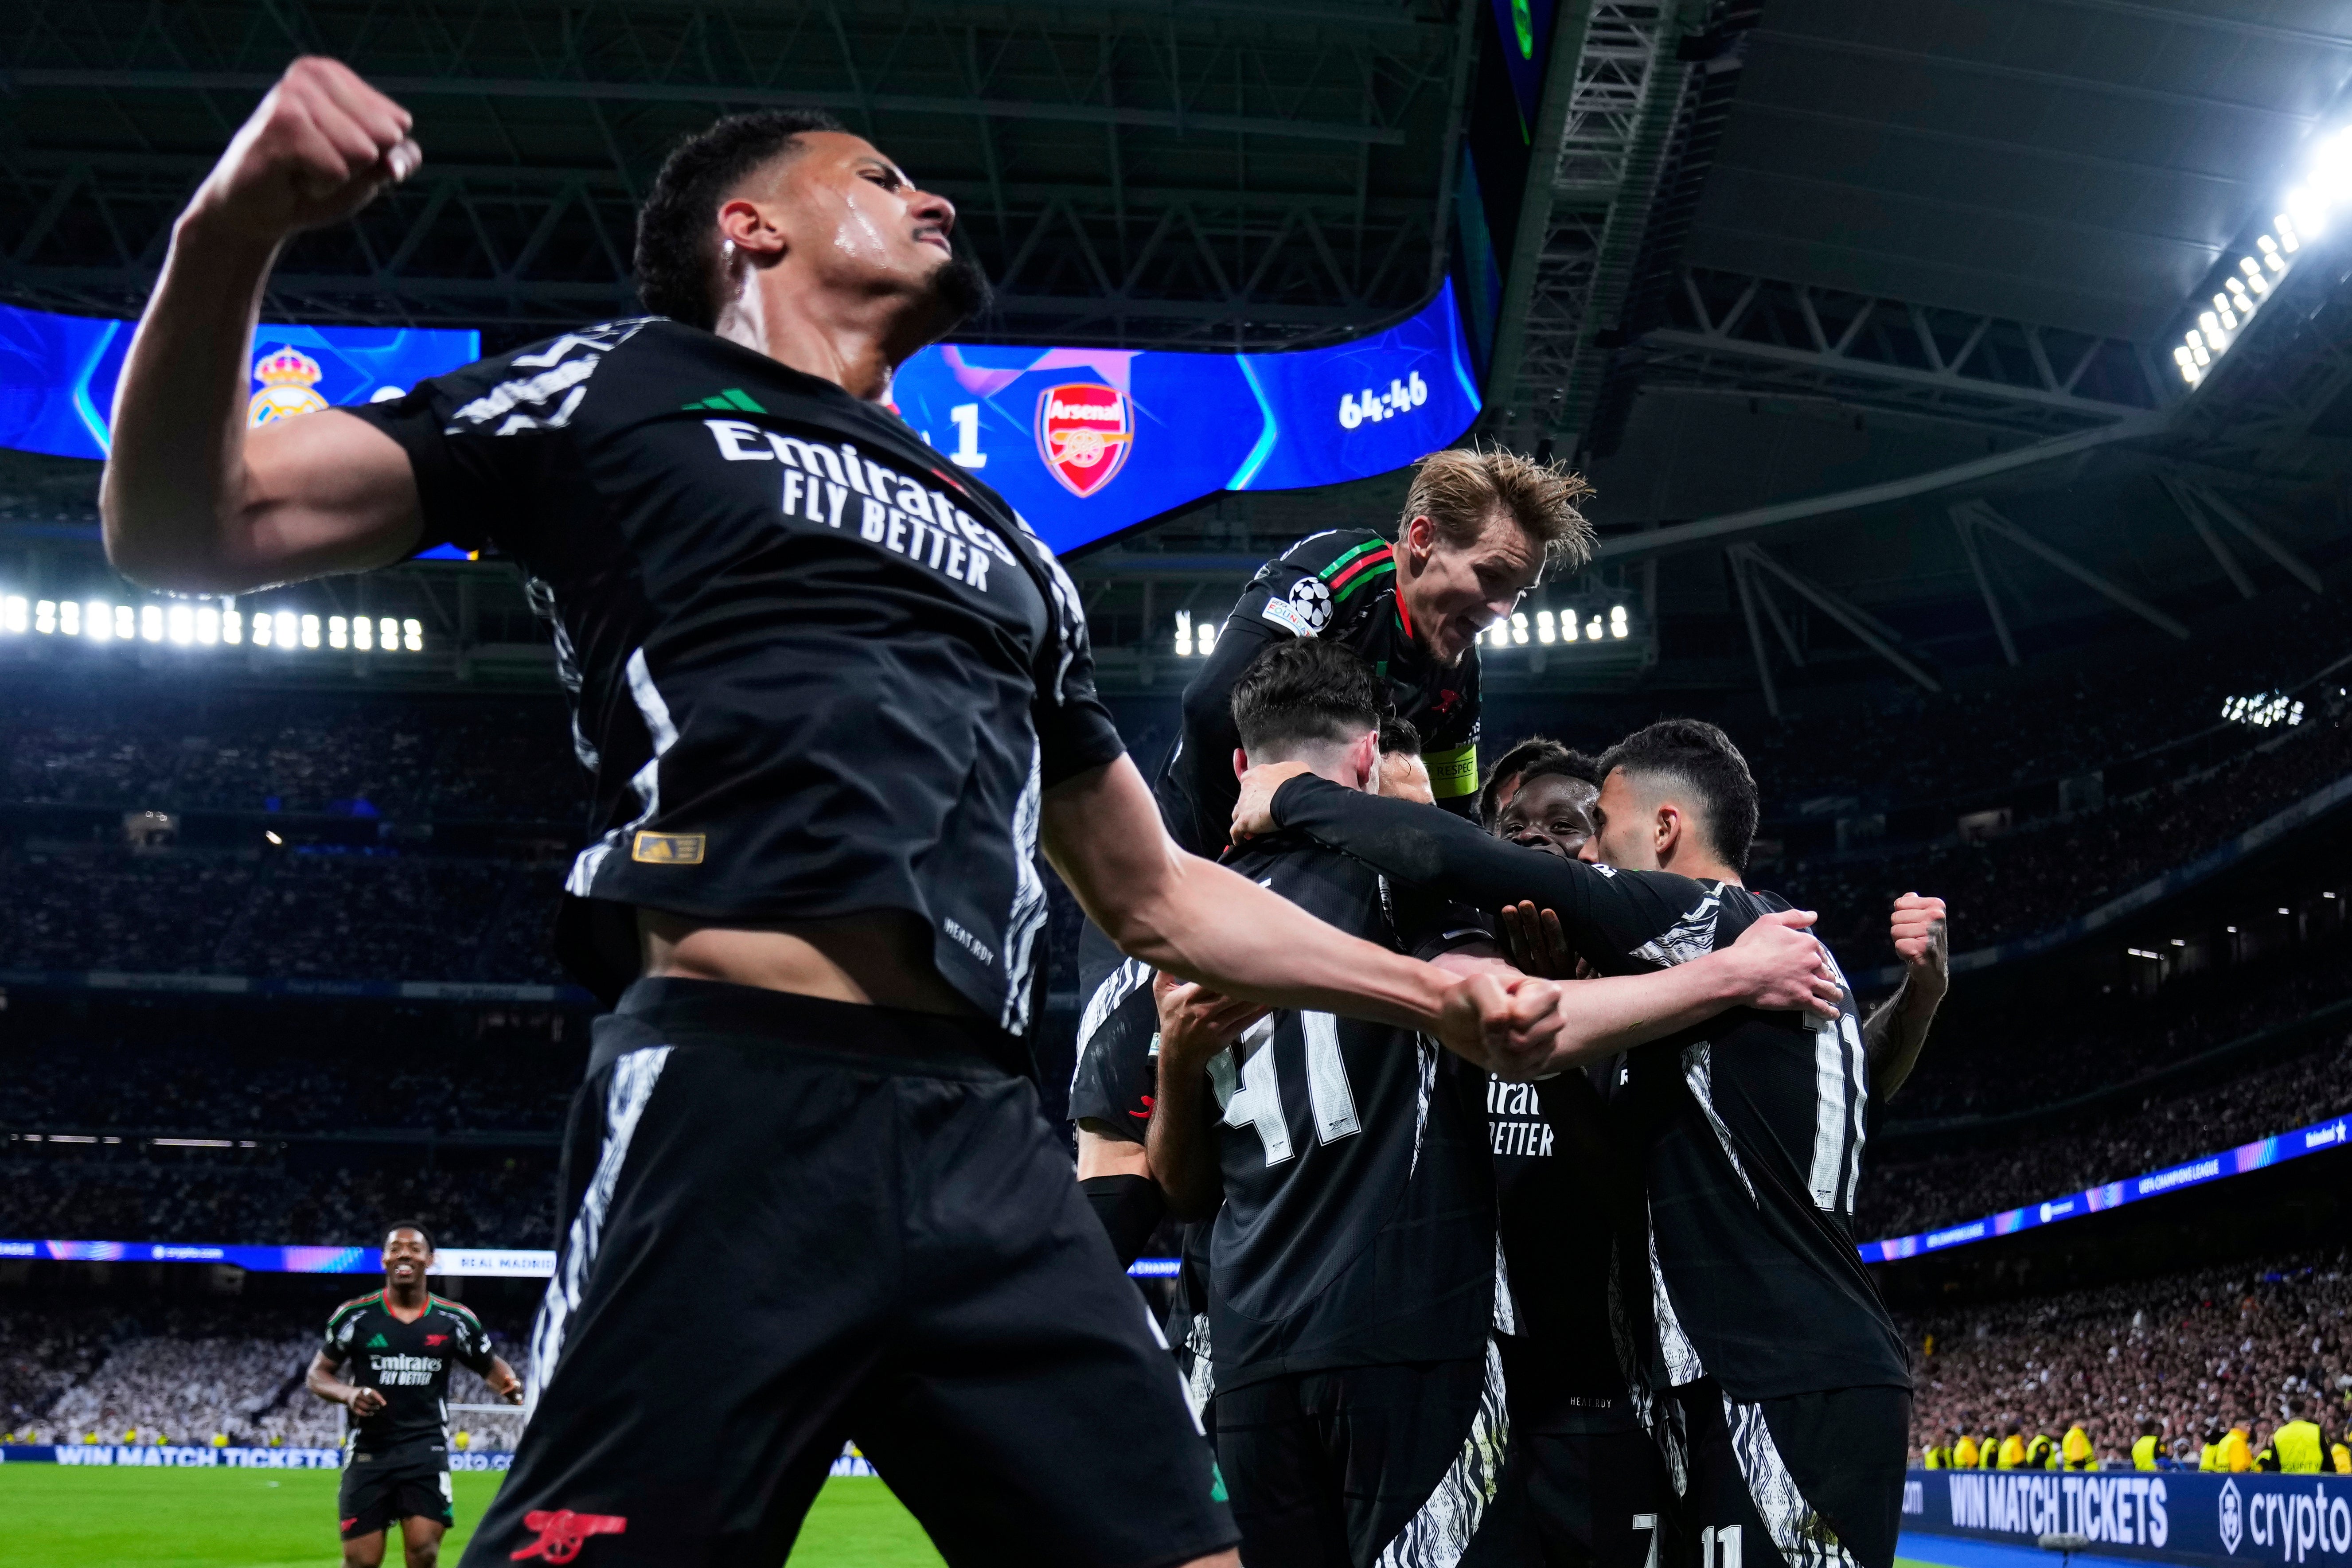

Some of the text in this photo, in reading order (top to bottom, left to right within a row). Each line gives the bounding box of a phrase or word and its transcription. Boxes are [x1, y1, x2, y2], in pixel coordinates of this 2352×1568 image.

[1049, 399, 1120, 421] Arsenal
[1338, 370, 1428, 429] 64:46
[949, 403, 987, 468] 1
[704, 420, 1017, 566] Emirates
[783, 469, 991, 592] FLY BETTER
[1268, 604, 1311, 637] FOUNDAT
[1437, 761, 1474, 776] RESPECT
[1487, 1072, 1540, 1115] irat
[1803, 1010, 1868, 1216] 11
[369, 1353, 442, 1372] Emirates
[379, 1371, 433, 1386] FLY BETTER
[1570, 1396, 1611, 1408] HEAT.RDY
[55, 1445, 113, 1466] WIN
[117, 1446, 218, 1467] MATCH
[223, 1448, 339, 1470] TICKETS
[1949, 1474, 1987, 1528] WIN
[1988, 1475, 2060, 1536] MATCH
[2063, 1477, 2169, 1548] TICKETS
[2250, 1482, 2352, 1564] crypto
